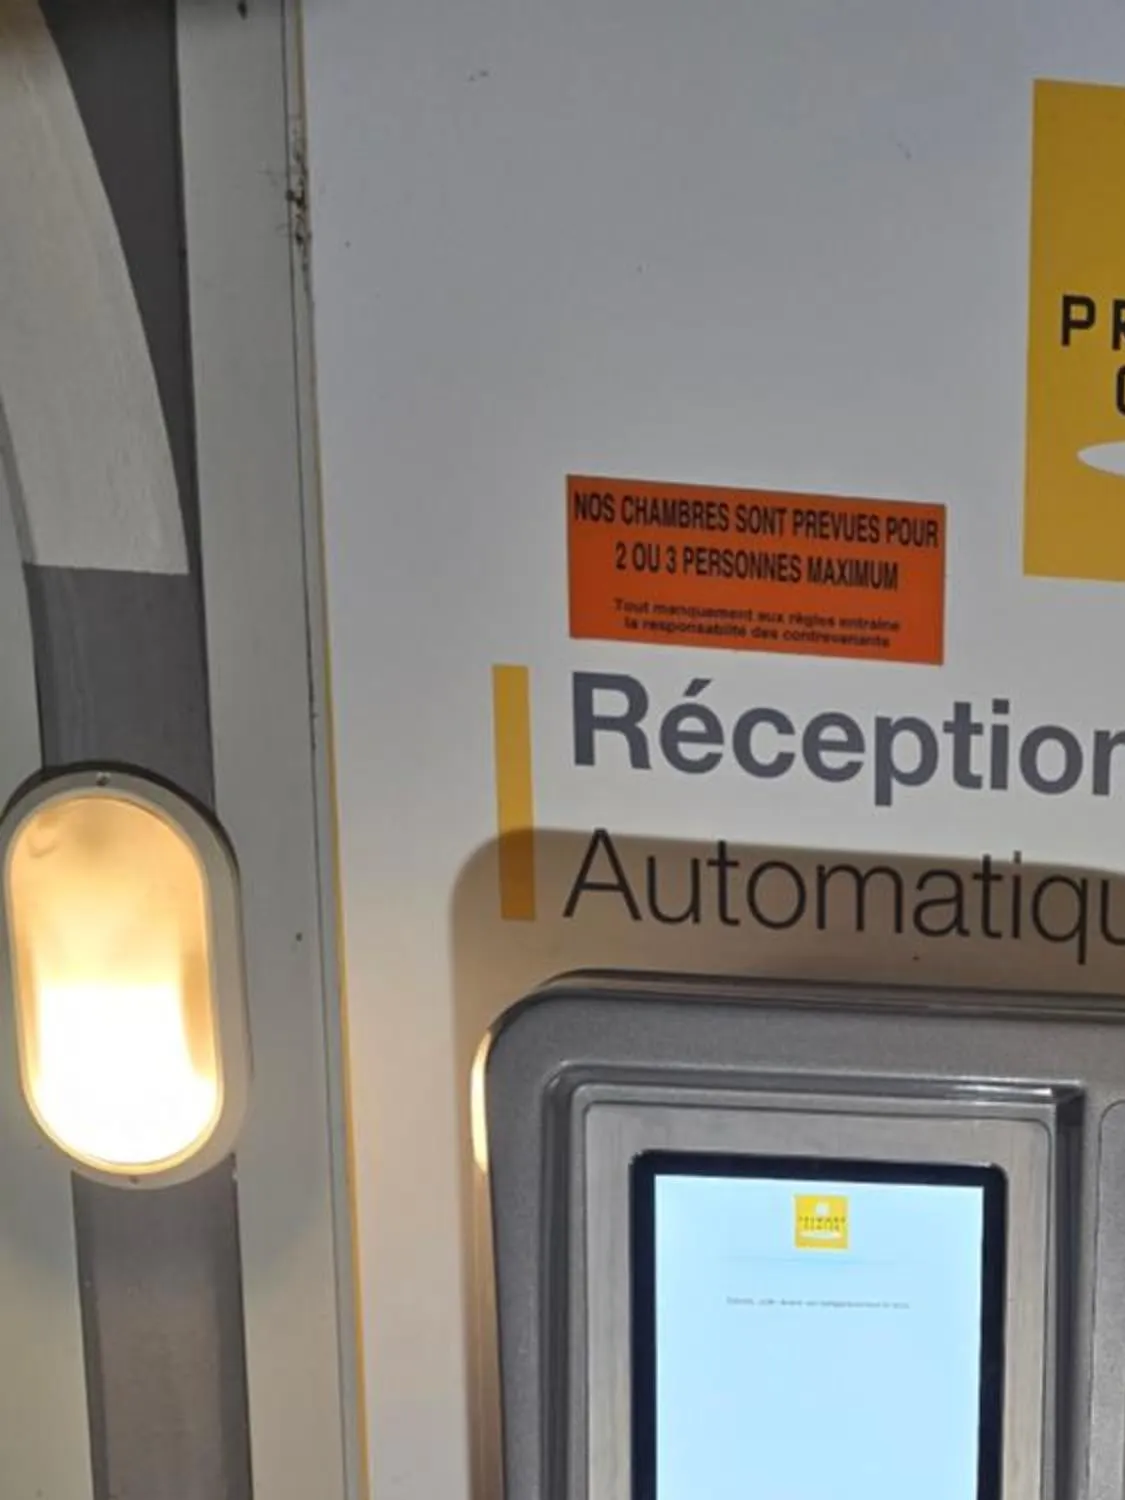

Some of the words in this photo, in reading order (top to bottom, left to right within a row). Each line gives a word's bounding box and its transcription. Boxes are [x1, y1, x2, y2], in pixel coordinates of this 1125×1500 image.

[574, 491, 615, 523] NOS
[620, 495, 730, 532] CHAMBRES
[735, 504, 788, 537] SONT
[793, 509, 880, 544] PREVUES
[885, 516, 939, 548] POUR
[615, 541, 627, 570] 2
[632, 543, 662, 573] OU
[666, 546, 677, 574] 3
[683, 548, 801, 583] PERSONNES
[806, 556, 899, 590] MAXIMUM
[614, 598, 649, 614] Tout
[653, 601, 752, 624] manquement
[758, 611, 784, 624] aux
[624, 615, 638, 630] la
[751, 624, 778, 641] des
